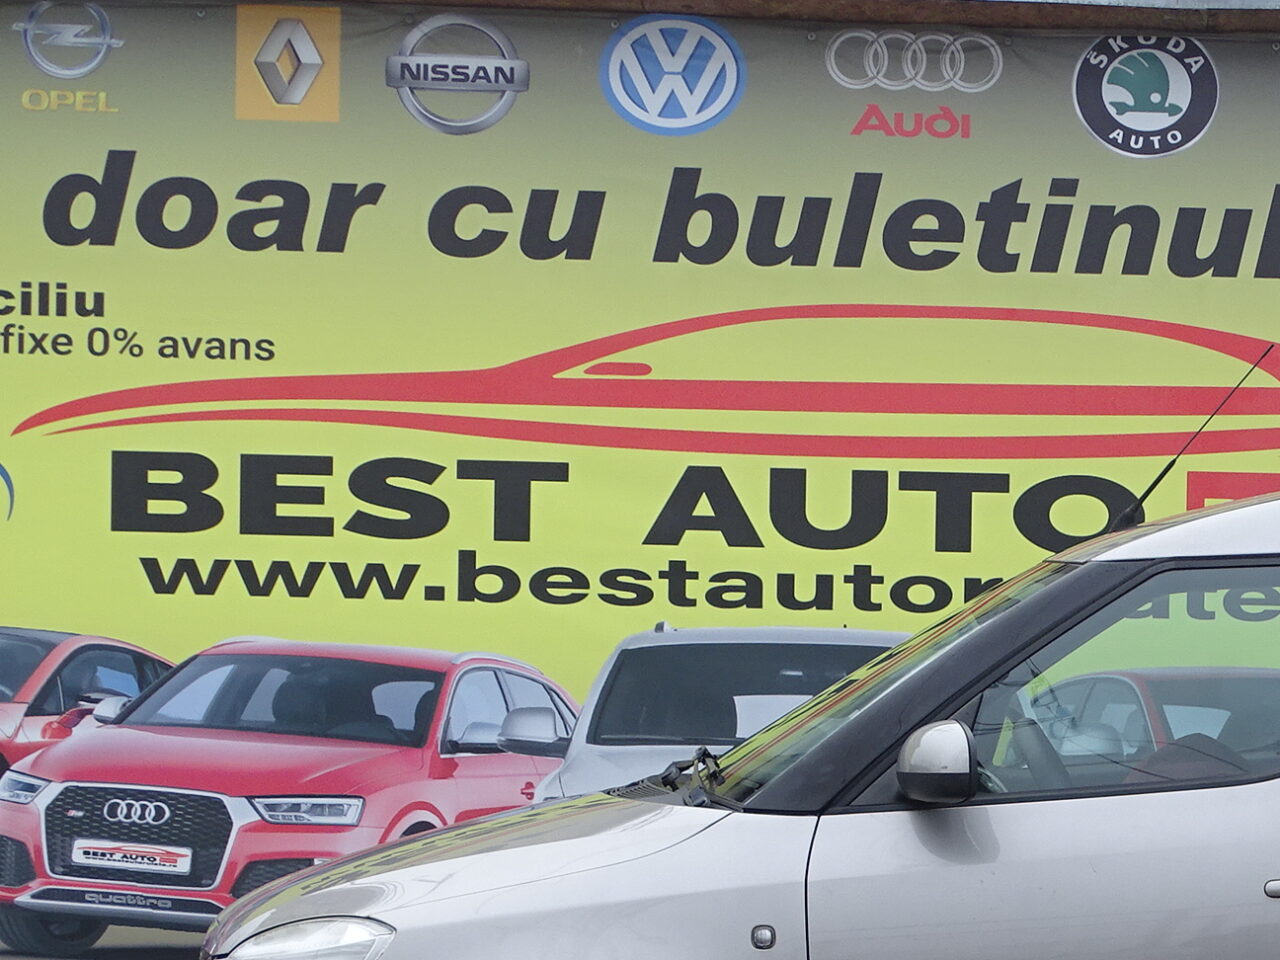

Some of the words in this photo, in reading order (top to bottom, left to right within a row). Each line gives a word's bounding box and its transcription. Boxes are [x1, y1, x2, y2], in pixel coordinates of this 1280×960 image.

[399, 62, 516, 85] NISSAN
[21, 88, 119, 114] OPEL
[1108, 129, 1182, 150] AUTO
[42, 149, 387, 254] doar
[426, 184, 607, 261] cu
[0, 323, 74, 356] fixe
[88, 327, 144, 357] 0%
[157, 335, 276, 361] avans
[110, 450, 570, 541] BEST
[642, 465, 1146, 553] AUTO
